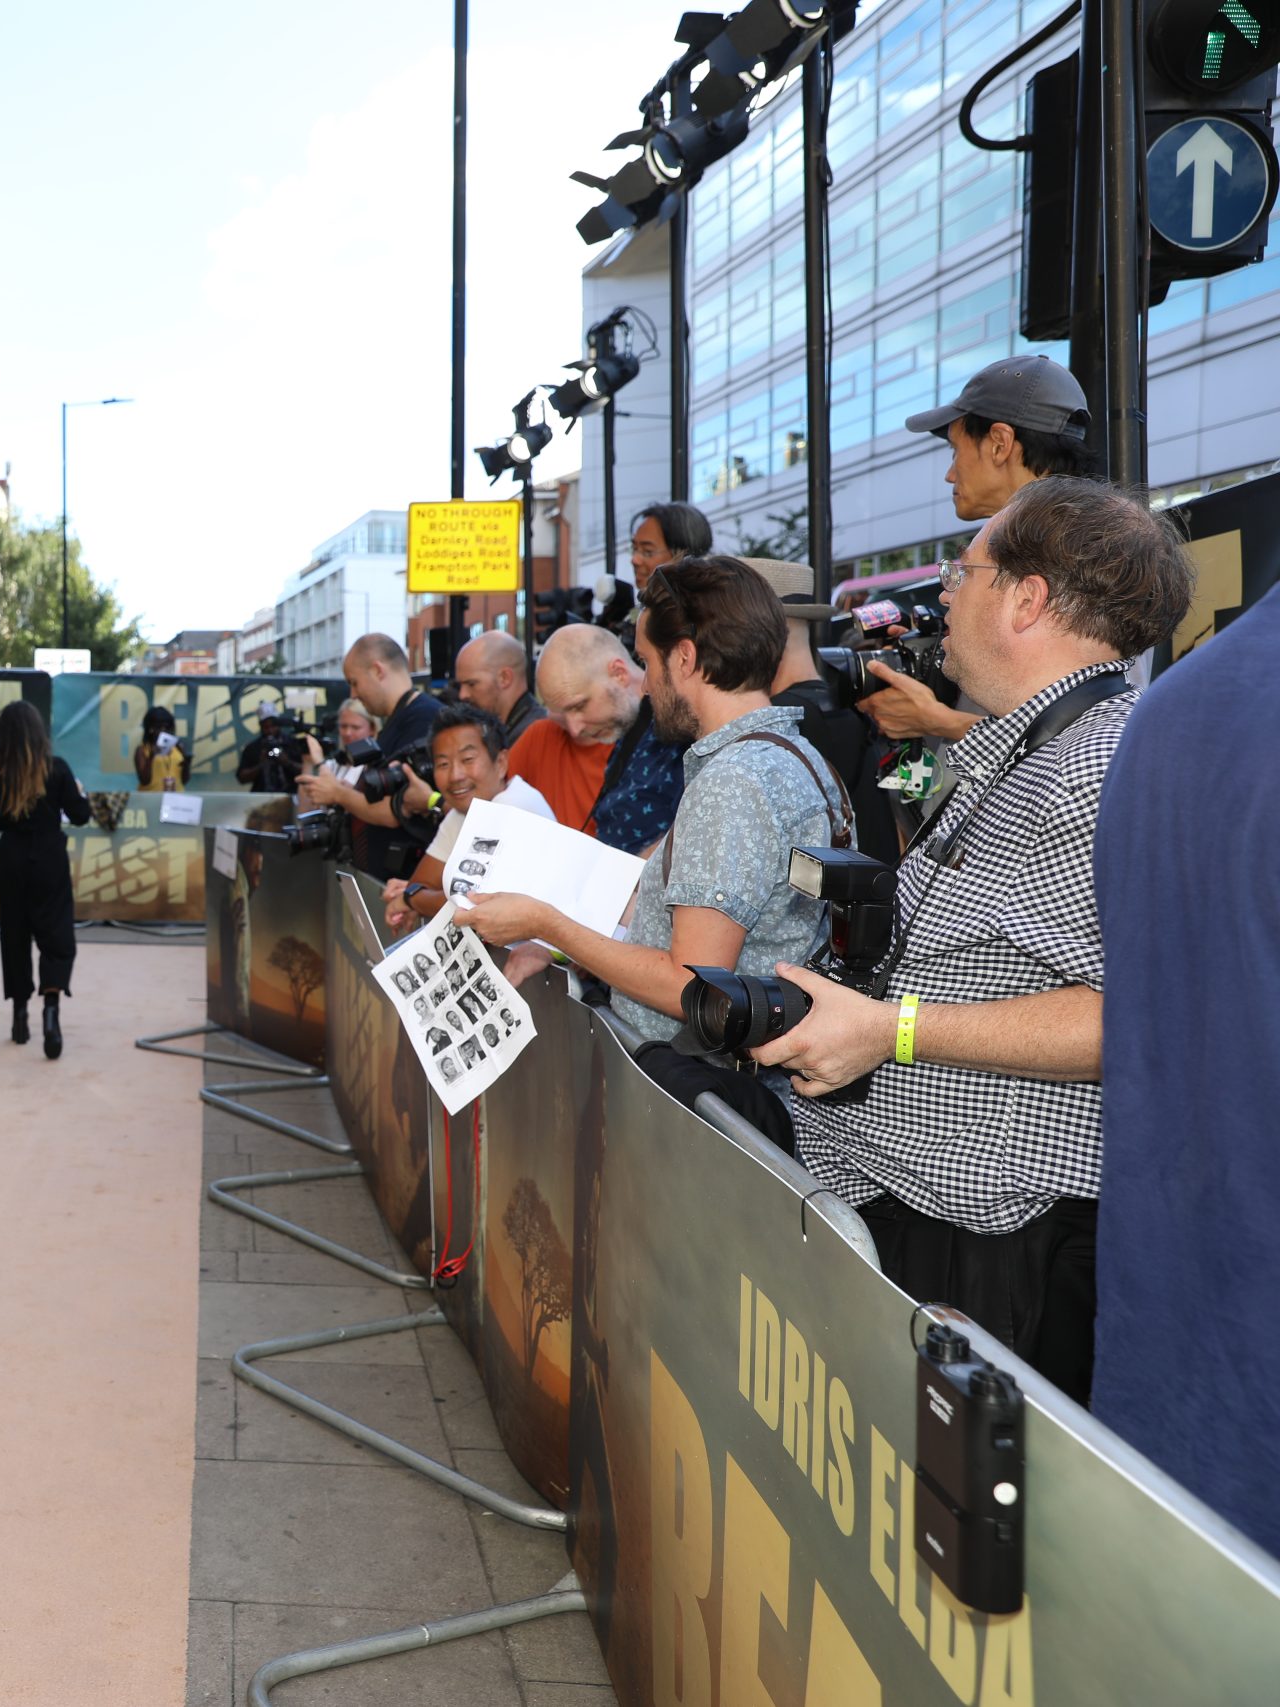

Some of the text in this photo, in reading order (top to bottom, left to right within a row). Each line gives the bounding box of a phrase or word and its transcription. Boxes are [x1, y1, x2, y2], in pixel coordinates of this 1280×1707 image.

[417, 508, 512, 518] NO THROUGH
[429, 522, 475, 532] ROUTE
[475, 535, 508, 545] Road
[479, 548, 511, 557] Road
[482, 561, 510, 571] Park
[447, 575, 480, 585] Road
[827, 971, 843, 982] SONY
[738, 1273, 855, 1537] IDRIS
